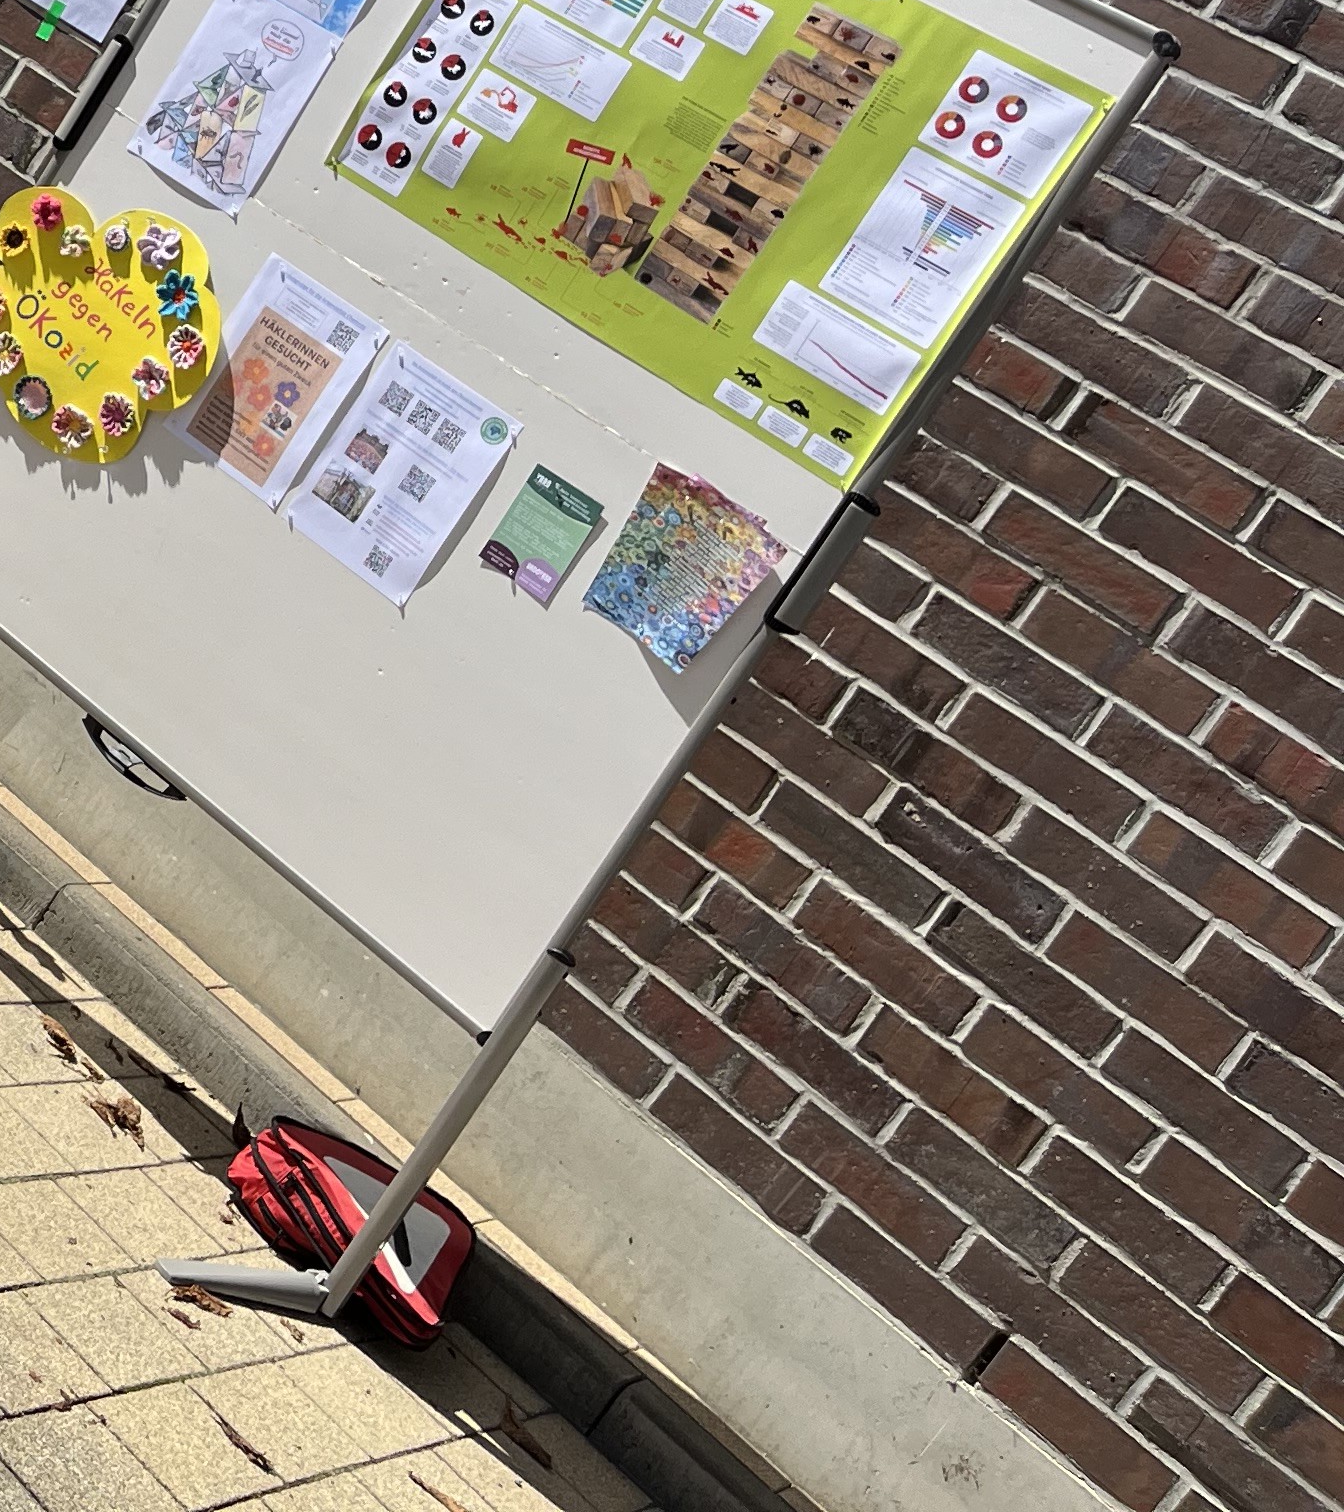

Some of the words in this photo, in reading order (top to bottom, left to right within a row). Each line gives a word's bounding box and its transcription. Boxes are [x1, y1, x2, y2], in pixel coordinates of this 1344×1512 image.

[16, 289, 99, 381] Ökozid
[51, 281, 112, 342] gegen
[259, 315, 331, 370] HÄKLERINNEN
[264, 333, 313, 372] GESUCHT
